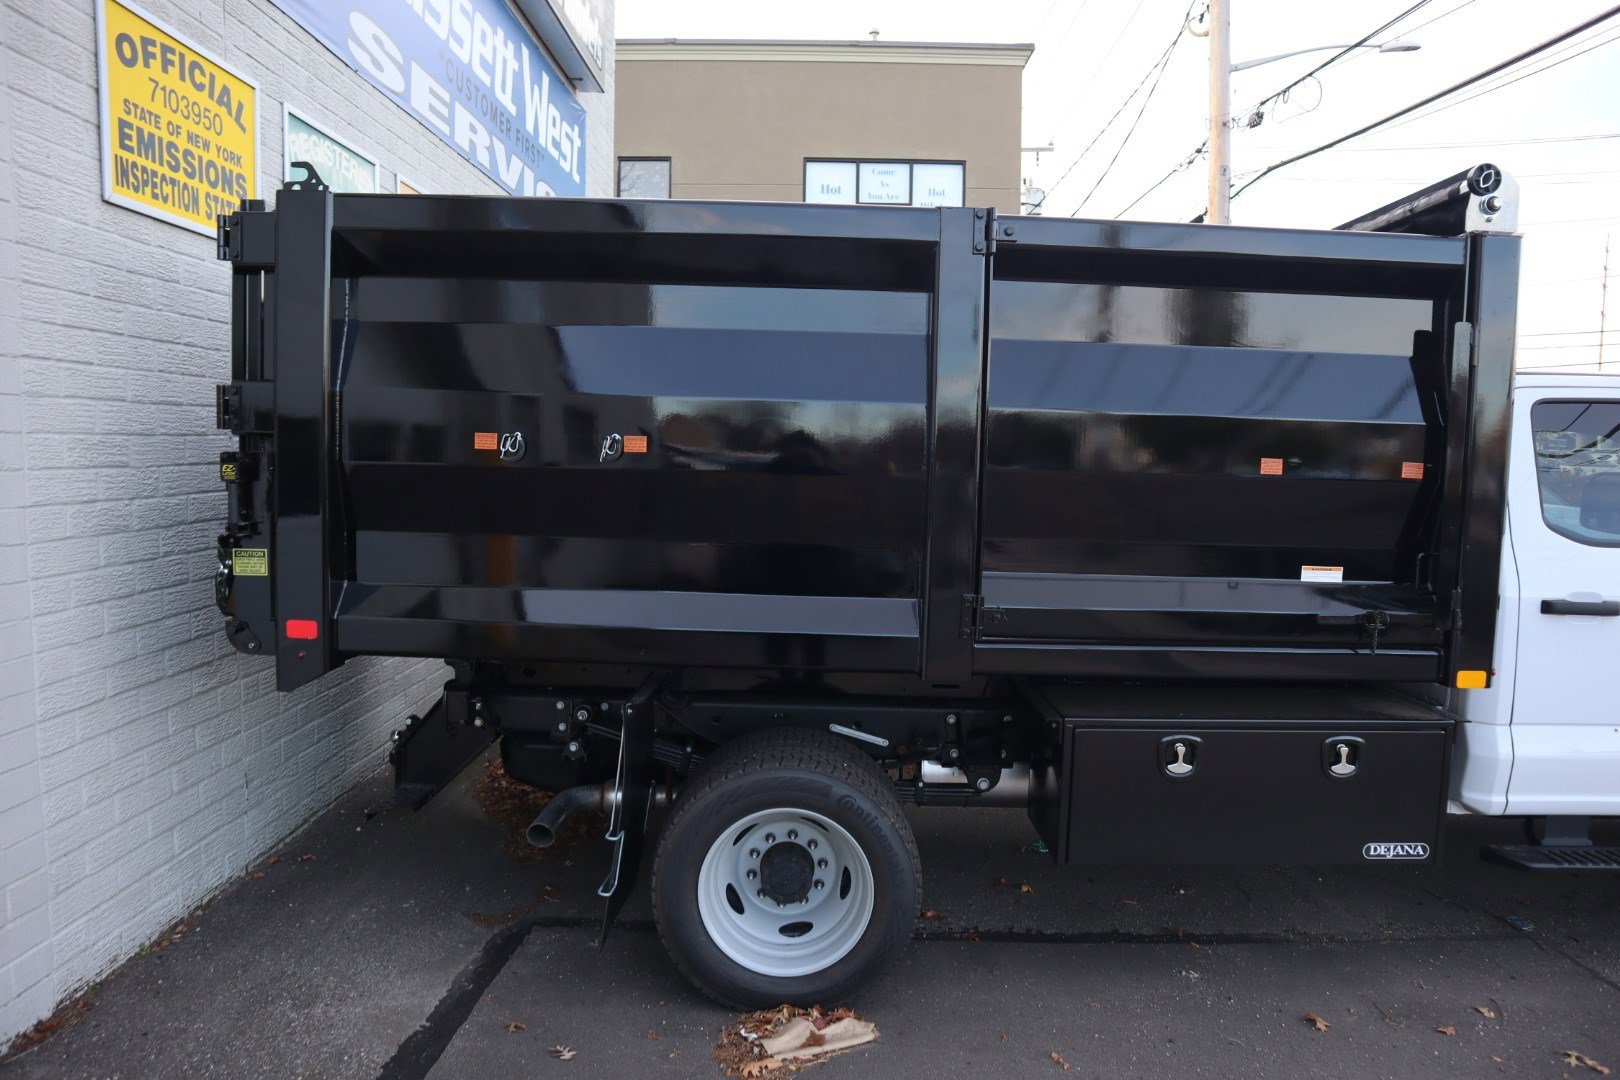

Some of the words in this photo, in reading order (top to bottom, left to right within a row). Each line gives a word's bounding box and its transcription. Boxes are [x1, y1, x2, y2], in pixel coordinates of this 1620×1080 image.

[115, 32, 247, 135] OFFICIAL
[148, 76, 223, 137] 7103950
[521, 42, 581, 184] West
[117, 116, 248, 201] EMISSIONS
[123, 98, 162, 131] STATE
[166, 120, 182, 140] OF
[186, 130, 211, 154] NEW
[215, 143, 243, 169] YORK
[114, 153, 200, 217] INSPECTION
[820, 183, 842, 195] Hot
[872, 166, 896, 176] Come
[928, 187, 945, 197] Hot
[1369, 844, 1424, 858] DEJANA
